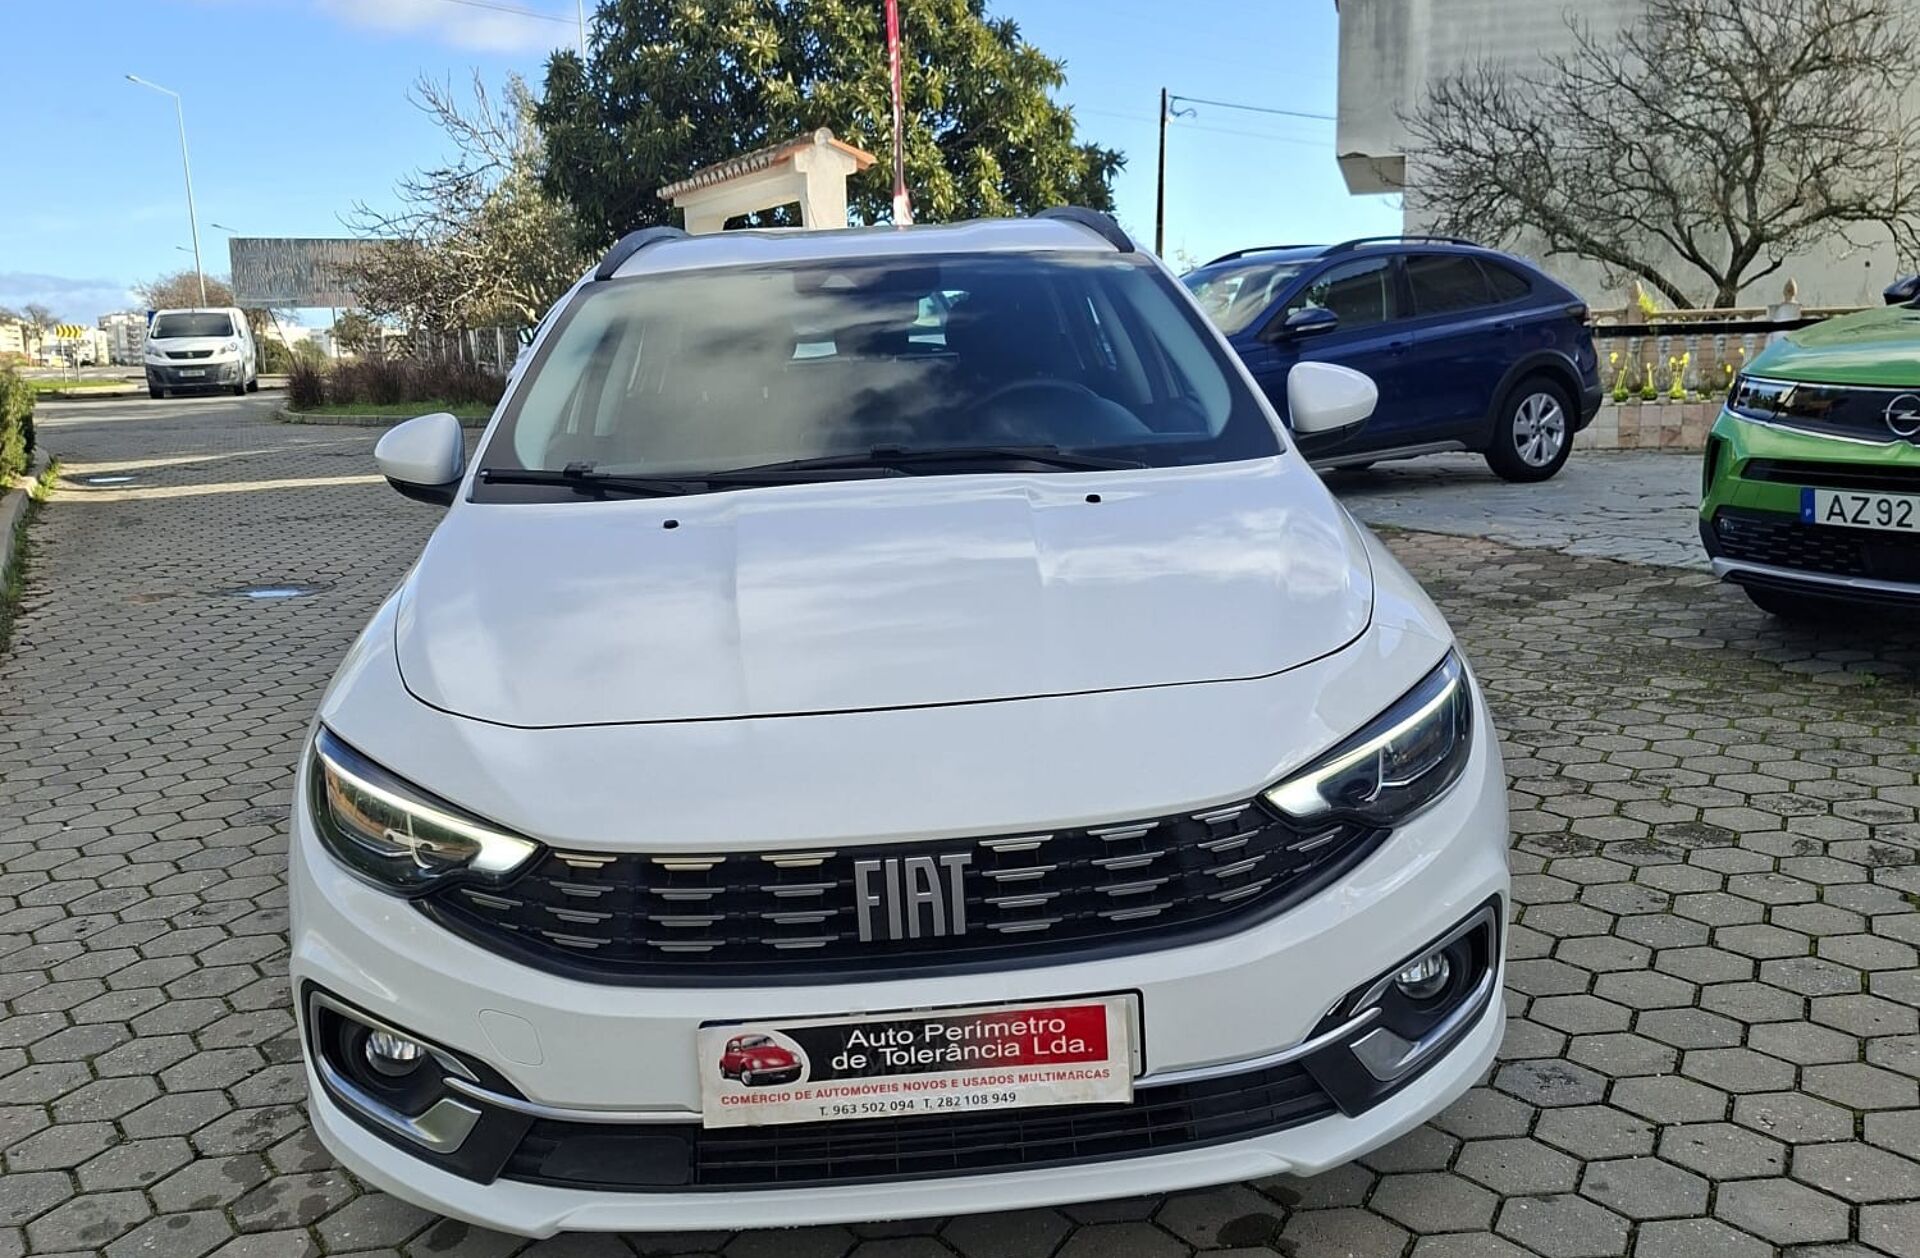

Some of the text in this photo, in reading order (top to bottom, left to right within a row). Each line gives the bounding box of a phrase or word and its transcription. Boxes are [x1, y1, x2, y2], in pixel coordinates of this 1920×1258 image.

[854, 853, 972, 942] FIAT
[847, 1017, 1066, 1049] Auto Perímetro
[831, 1035, 1094, 1070] de Tolerância Lda.
[721, 1068, 1110, 1105] COMÉRCIO DE AUTOMÓVEIS NOVOS E USADOS MULTIMARCAS
[819, 1092, 1016, 1116] T. 963 502 094 T. 282 108 949
